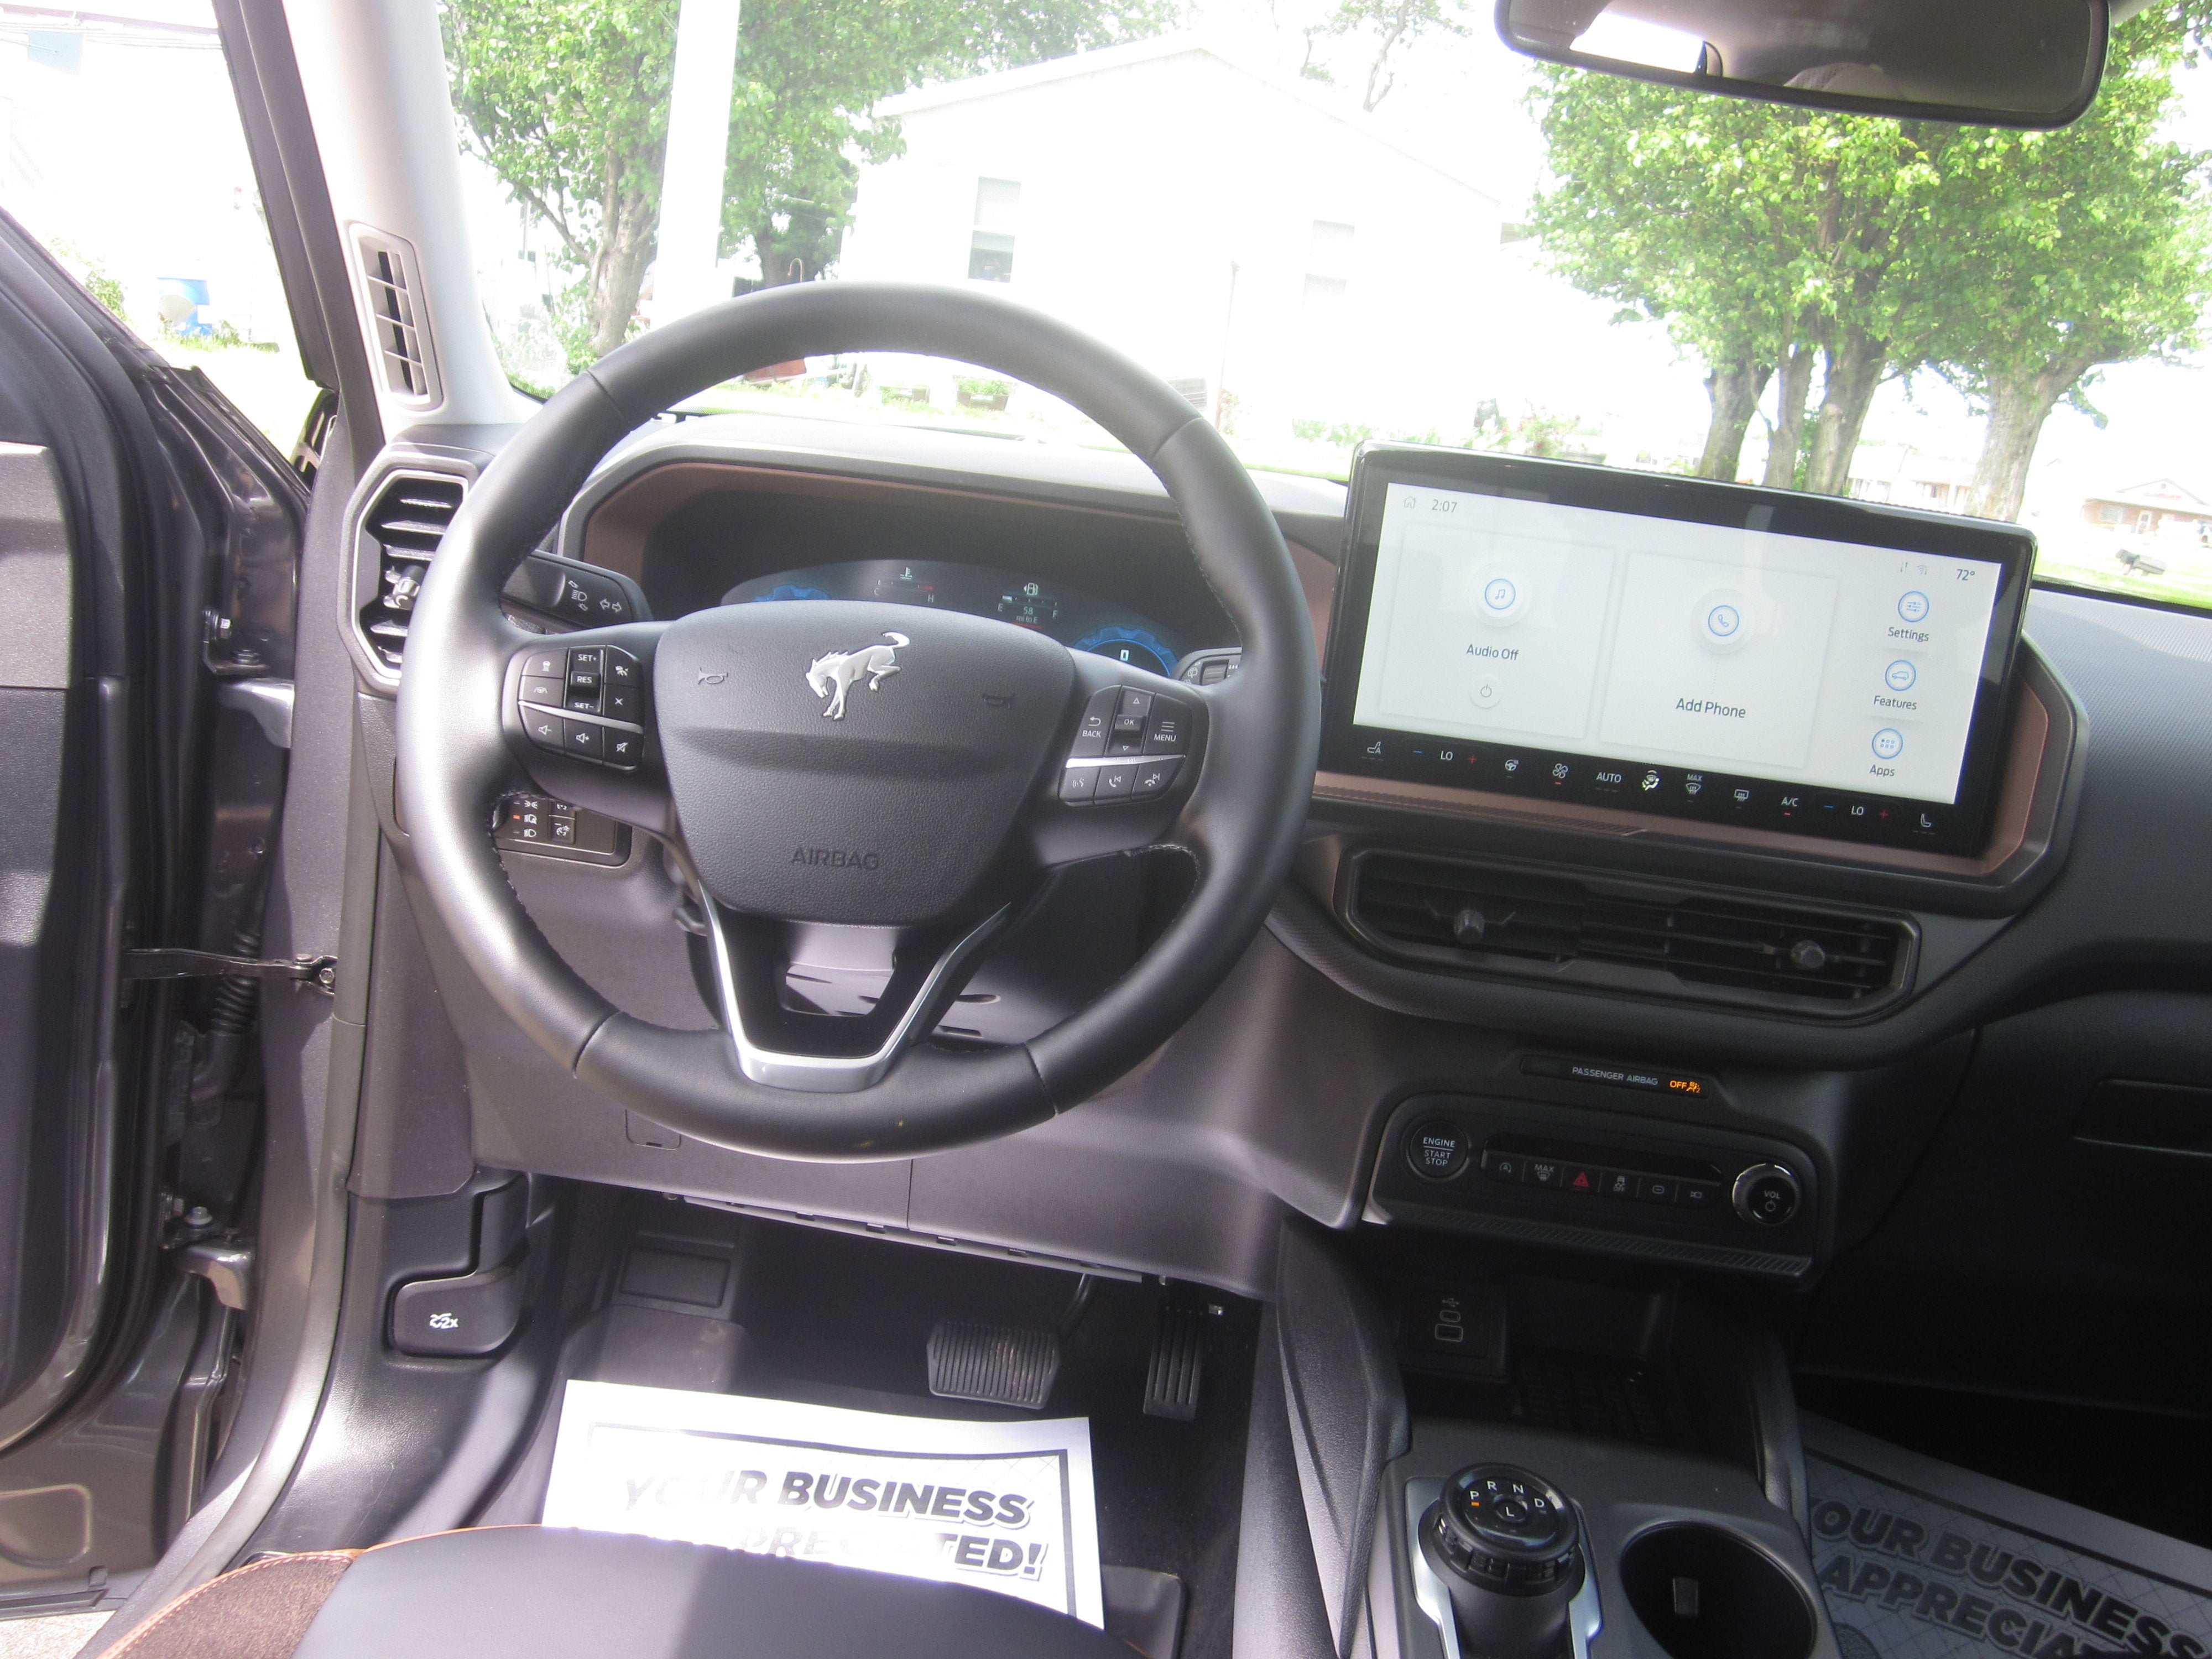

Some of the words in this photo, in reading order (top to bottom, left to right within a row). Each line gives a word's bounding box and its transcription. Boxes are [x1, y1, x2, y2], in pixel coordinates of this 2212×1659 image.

[1432, 499, 1458, 513] 2:07
[1956, 568, 1975, 581] 72°
[927, 594, 934, 602] H
[998, 603, 1003, 612] E
[1023, 606, 1034, 615] 58
[1052, 610, 1058, 618] F
[1887, 627, 1929, 643] Settings
[1120, 649, 1129, 661] 0
[1466, 644, 1499, 658] Audio
[1501, 648, 1520, 660] Off
[1676, 697, 1703, 713] Add
[1704, 701, 1746, 718] Phone
[1874, 695, 1918, 710] Features
[1082, 730, 1102, 738] BACK
[1154, 734, 1176, 742] MENU
[1440, 750, 1453, 761] LO
[1869, 764, 1895, 777] Apps
[1596, 771, 1622, 784] AUTO
[1687, 774, 1703, 782] MAX
[1781, 796, 1799, 807] A/C
[1851, 805, 1864, 816] LO
[791, 847, 879, 871] AIRBAG
[1572, 1067, 1624, 1081] PASSENGER
[1626, 1074, 1658, 1086] AIRBAG
[1670, 1080, 1687, 1089] OFF
[1423, 1137, 1455, 1148] ENGINE
[1425, 1150, 1451, 1159] START
[1426, 1157, 1448, 1166] STOP
[1534, 1164, 1554, 1172] MAX
[1764, 1190, 1780, 1199] VOL
[778, 1469, 1033, 1528] BUSINESS
[1470, 1490, 1479, 1500] P
[1487, 1480, 1497, 1491] R
[1512, 1484, 1524, 1494] N
[1534, 1498, 1545, 1507] D
[1505, 1506, 1514, 1517] L
[1808, 1497, 1927, 1558] OUR
